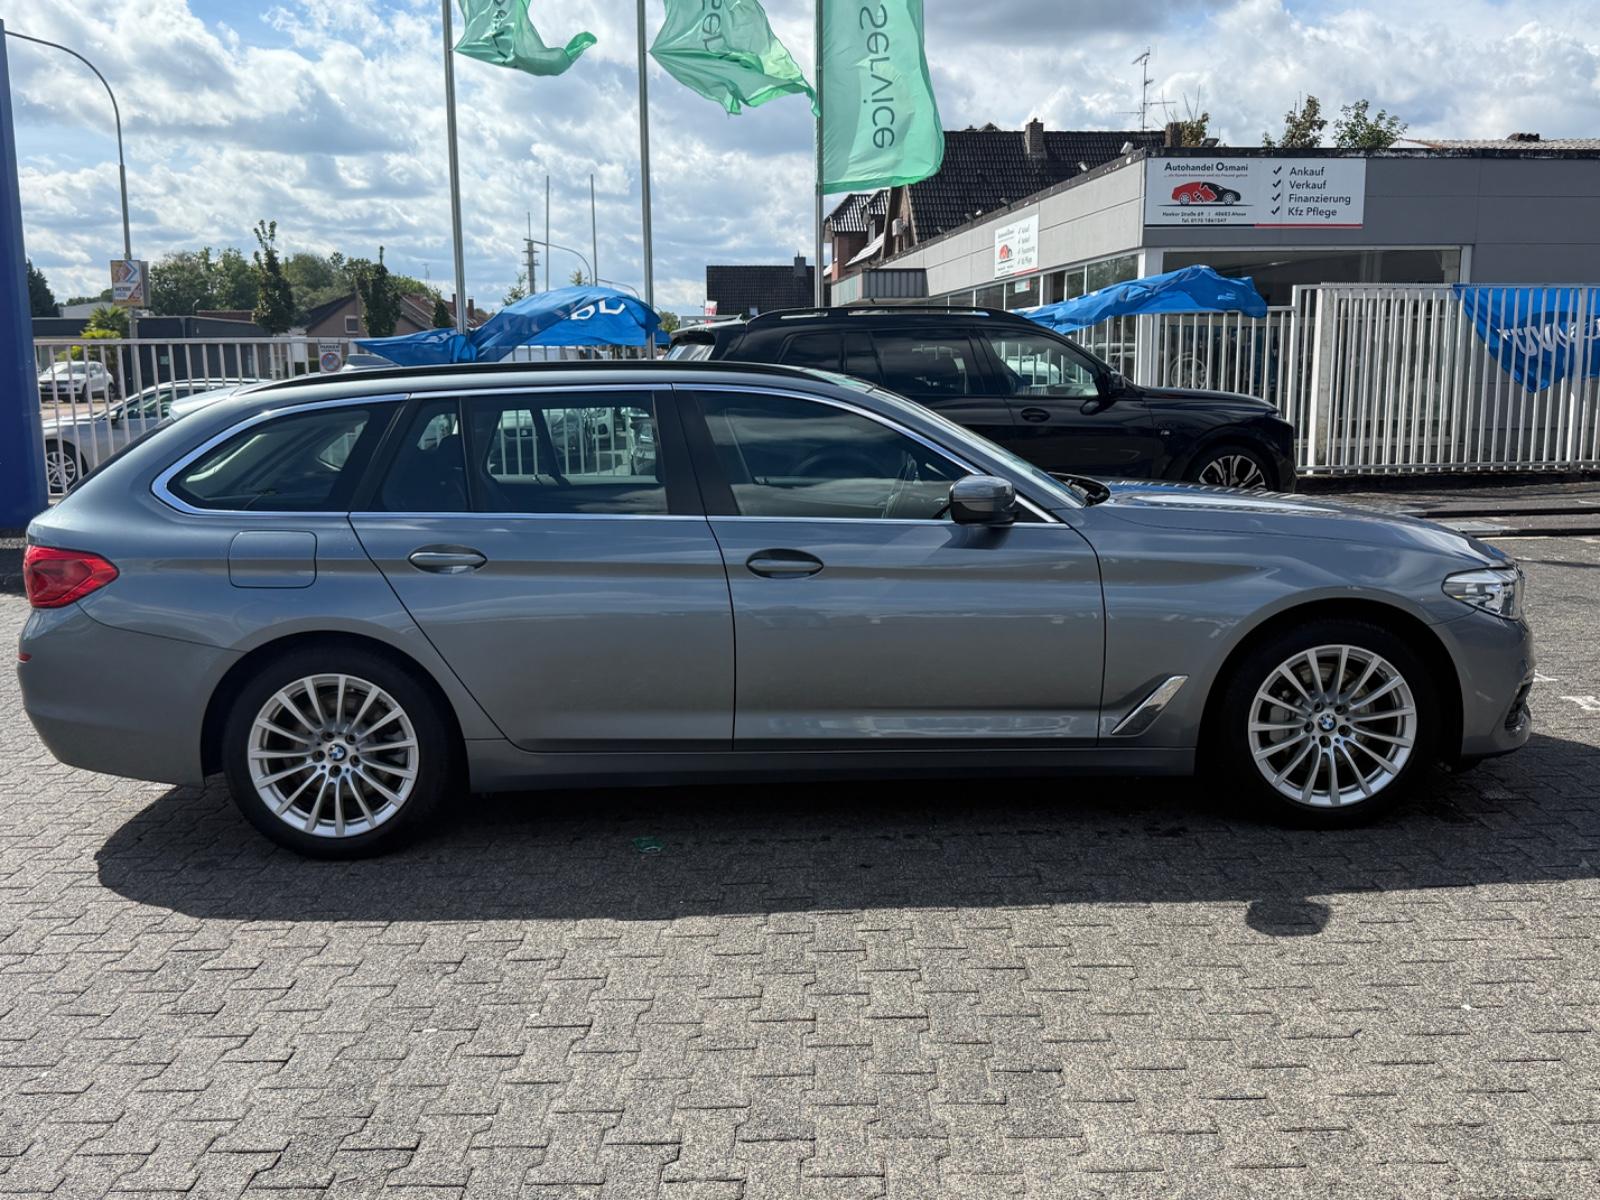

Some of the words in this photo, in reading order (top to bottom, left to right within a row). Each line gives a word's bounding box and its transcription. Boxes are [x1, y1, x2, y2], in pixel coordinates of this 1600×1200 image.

[1164, 162, 1214, 172] Autohandel
[1216, 162, 1248, 172] Osmani
[1289, 166, 1325, 176] Ankauf
[1289, 180, 1327, 190] Verkauf
[1289, 194, 1351, 205] Finanzierung
[1288, 206, 1304, 216] Kfz
[1306, 206, 1338, 219] Pflege
